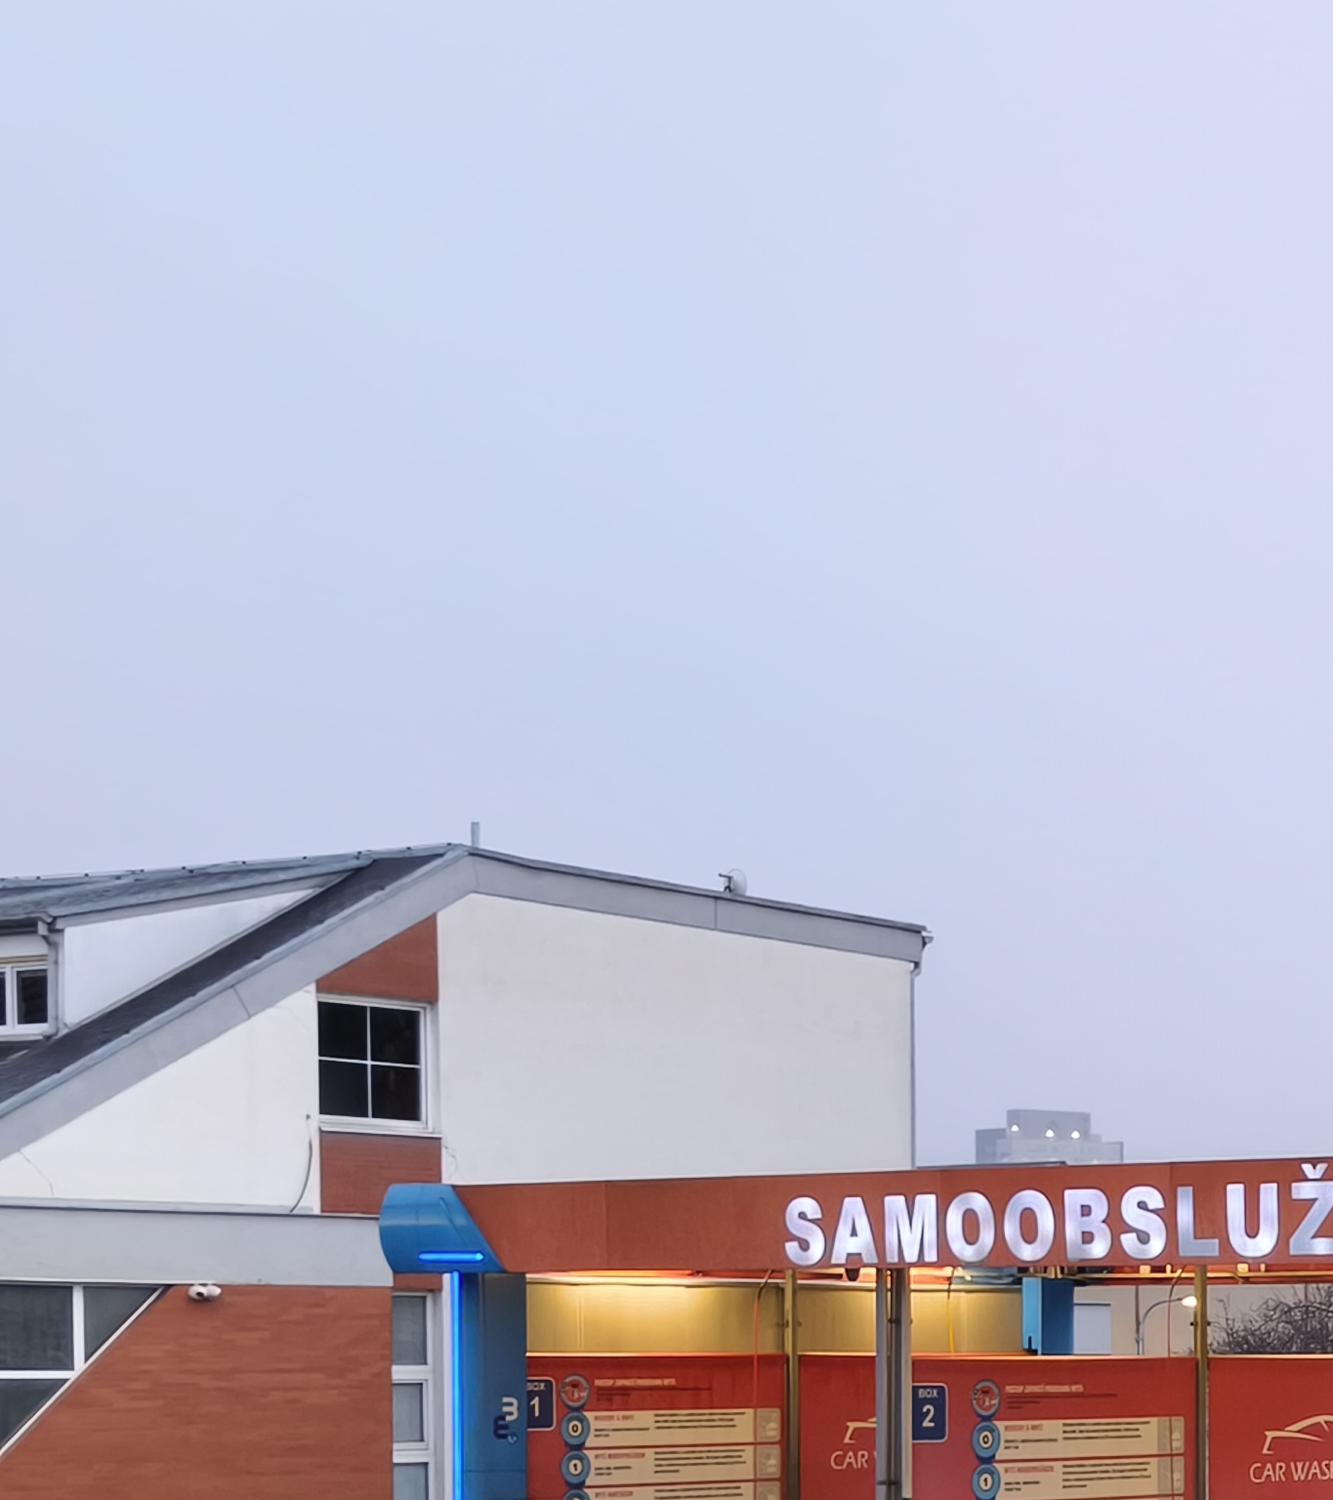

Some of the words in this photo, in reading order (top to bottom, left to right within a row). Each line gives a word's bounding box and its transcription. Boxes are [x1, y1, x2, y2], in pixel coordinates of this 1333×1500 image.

[918, 1388, 938, 1399] BOX
[530, 1396, 539, 1417] 1
[922, 1404, 935, 1428] 2
[830, 1450, 869, 1470] CAR
[1249, 1462, 1286, 1483] CAR
